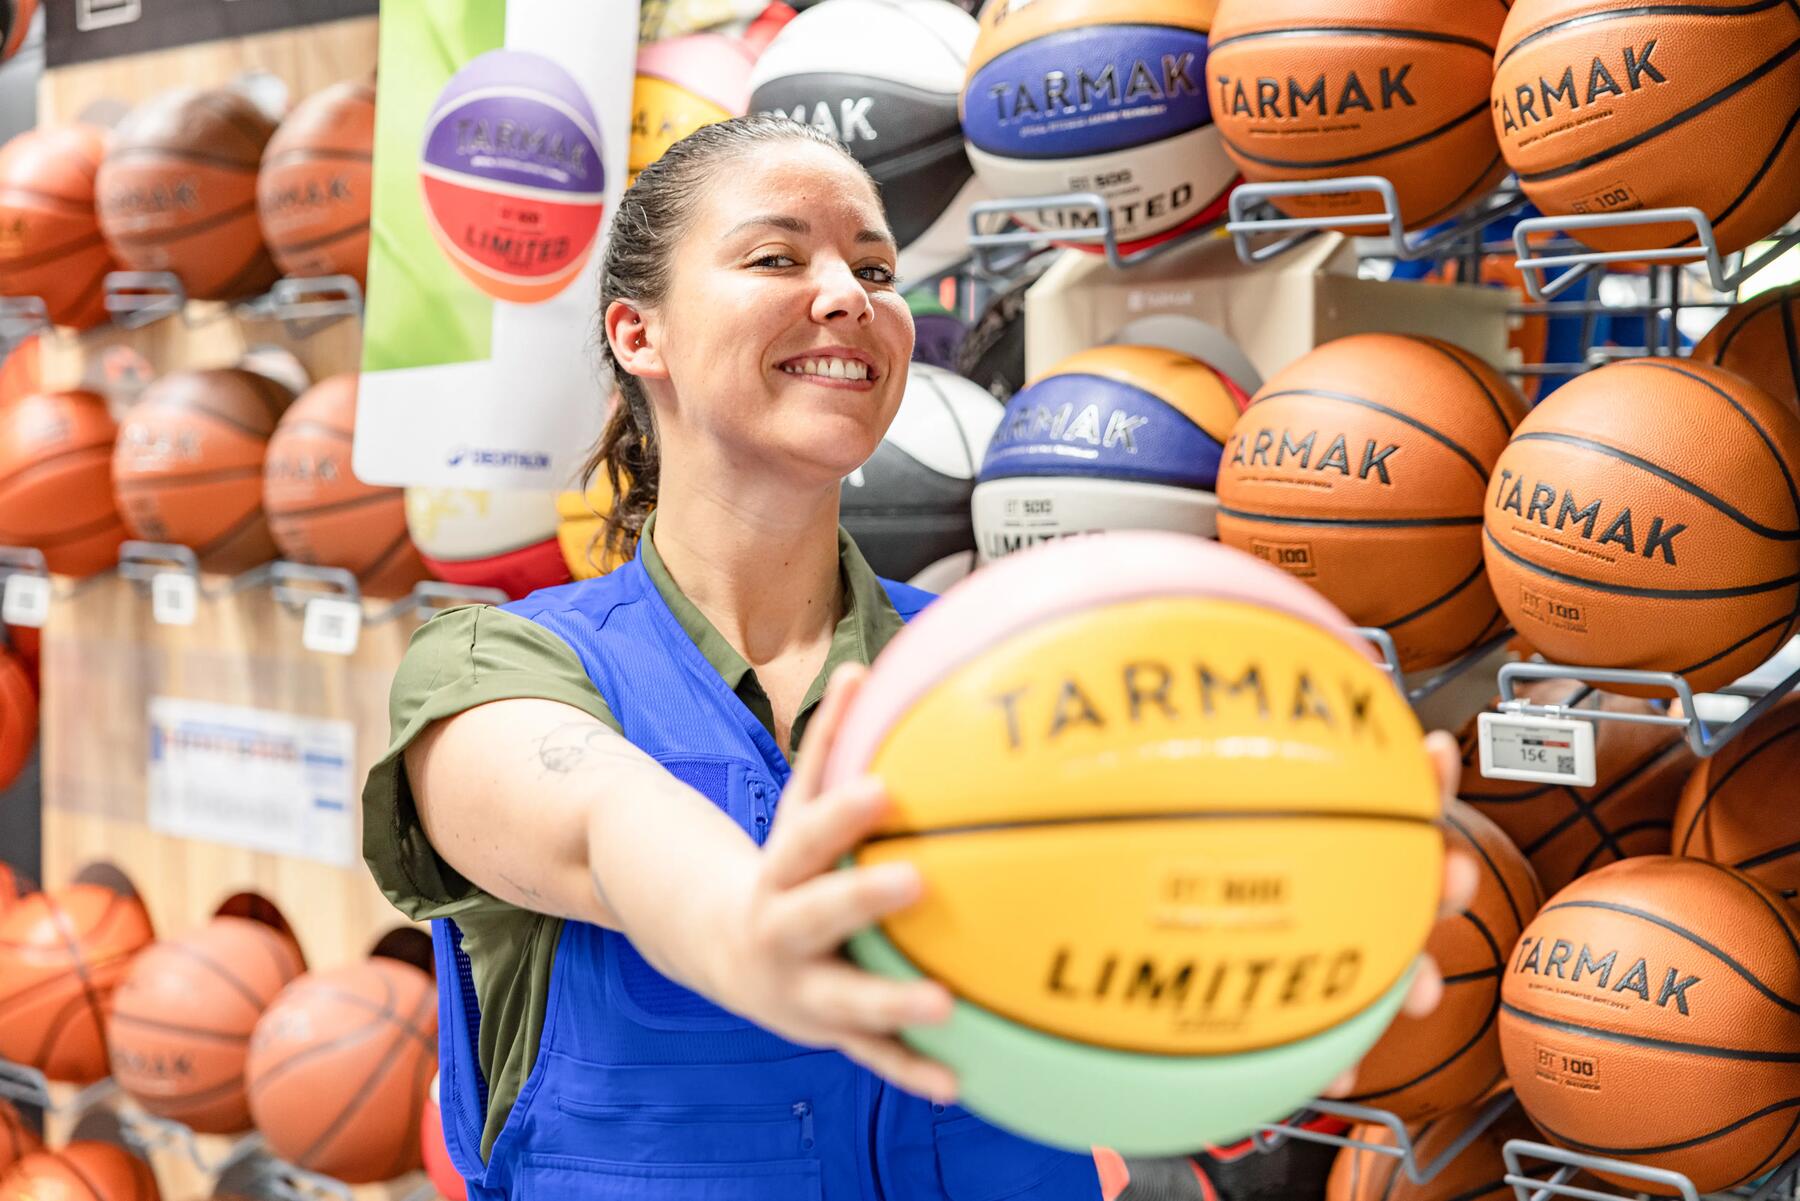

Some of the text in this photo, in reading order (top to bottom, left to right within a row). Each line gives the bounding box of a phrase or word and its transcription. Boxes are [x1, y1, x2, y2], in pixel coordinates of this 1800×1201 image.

[988, 53, 1199, 126] TARMAK
[1218, 63, 1416, 119] TARMAK
[1494, 39, 1668, 137] ARMAK
[1595, 188, 1630, 209] 100
[1229, 428, 1400, 485] ARMAK
[1496, 468, 1688, 567] TARMAK
[1277, 547, 1308, 564] 100
[1548, 601, 1580, 621] 100
[992, 660, 1390, 750] TARMAK
[1520, 747, 1547, 763] 15€
[1045, 944, 1365, 1014] LIMITED
[1514, 936, 1702, 1017] TARMAK
[1538, 1049, 1594, 1077] BT 100
